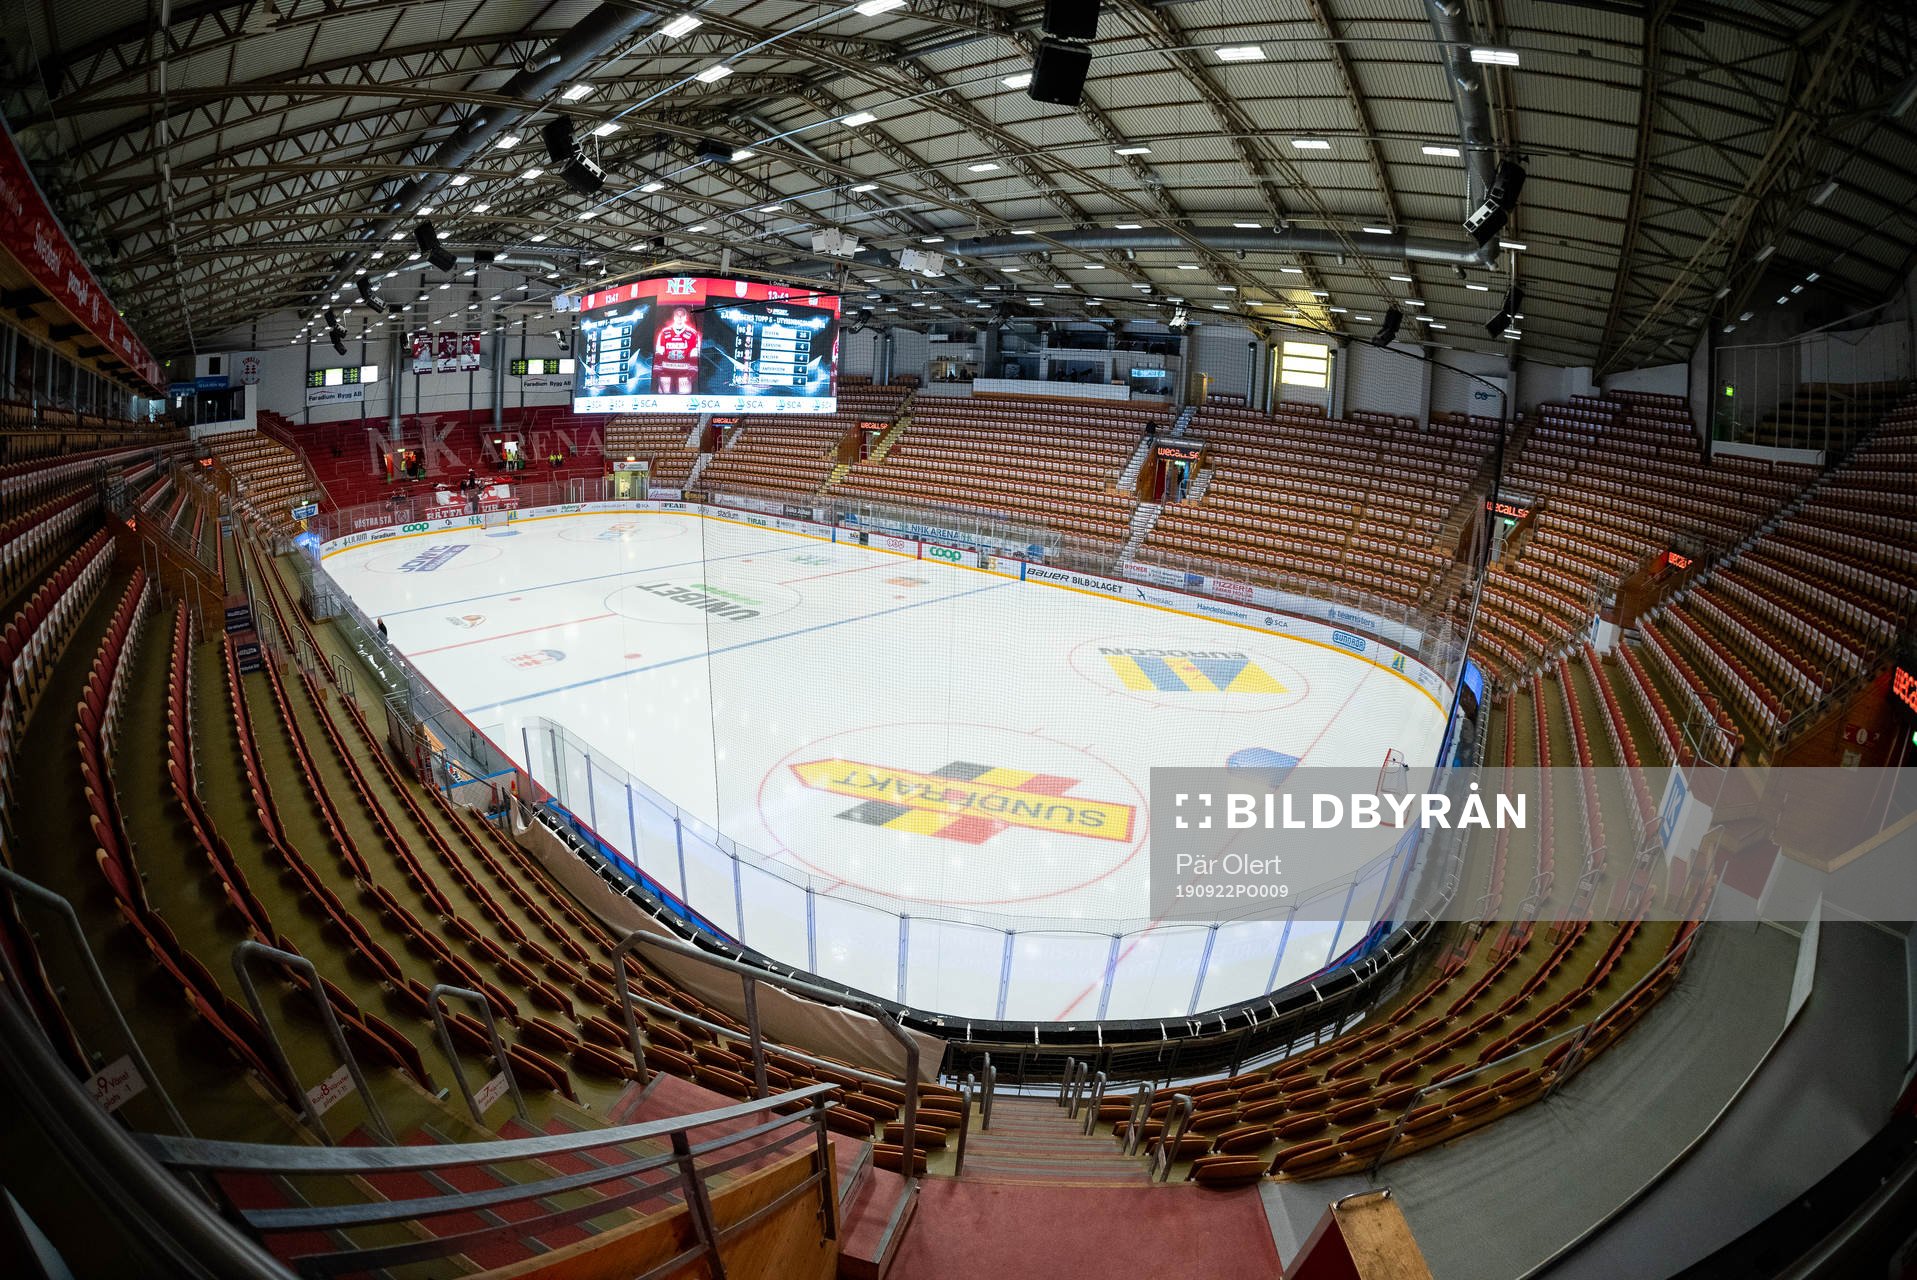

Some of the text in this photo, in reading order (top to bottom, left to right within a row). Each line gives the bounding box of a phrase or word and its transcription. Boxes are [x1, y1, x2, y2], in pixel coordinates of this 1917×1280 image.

[665, 278, 697, 295] NHK
[482, 502, 518, 512] VIRET
[402, 522, 429, 533] coop
[747, 517, 766, 526] TIRAB
[912, 524, 958, 538] NHK ARENA
[930, 546, 961, 561] coop
[1072, 576, 1123, 594] BILBOLAGET
[636, 582, 760, 622] UNIBET
[1196, 602, 1248, 620] Handelsbanken
[1274, 616, 1288, 628] SCA
[832, 770, 1107, 828] SUNDFRAKT
[97, 1076, 108, 1094] 9
[320, 1084, 330, 1096] 8
